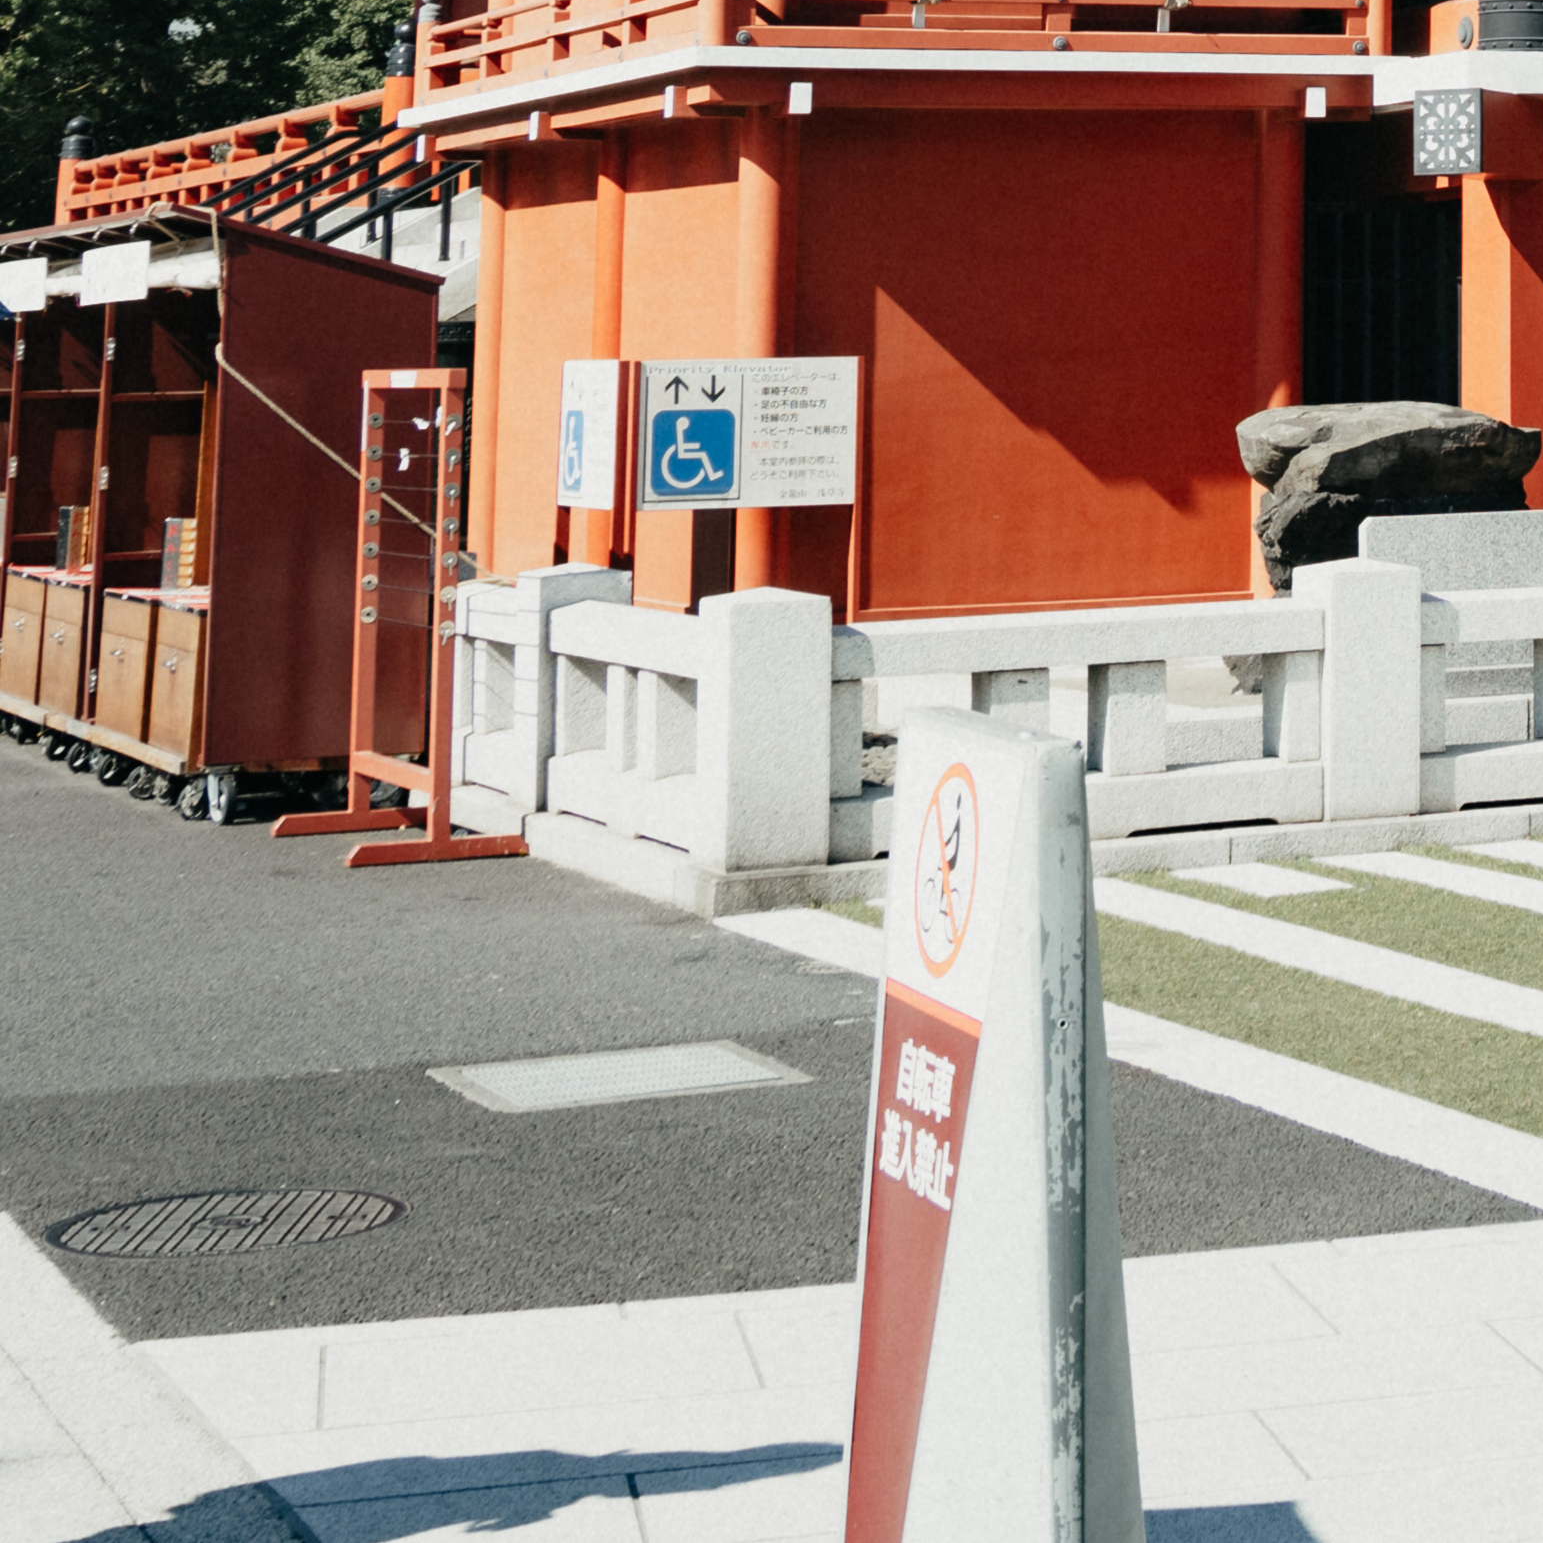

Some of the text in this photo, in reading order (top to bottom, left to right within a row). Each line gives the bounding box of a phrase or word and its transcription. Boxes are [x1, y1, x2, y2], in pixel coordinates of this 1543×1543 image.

[647, 364, 792, 376] Priority Elevator
[895, 1037, 958, 1122] 自転車
[878, 1108, 956, 1212] 進入禁止
